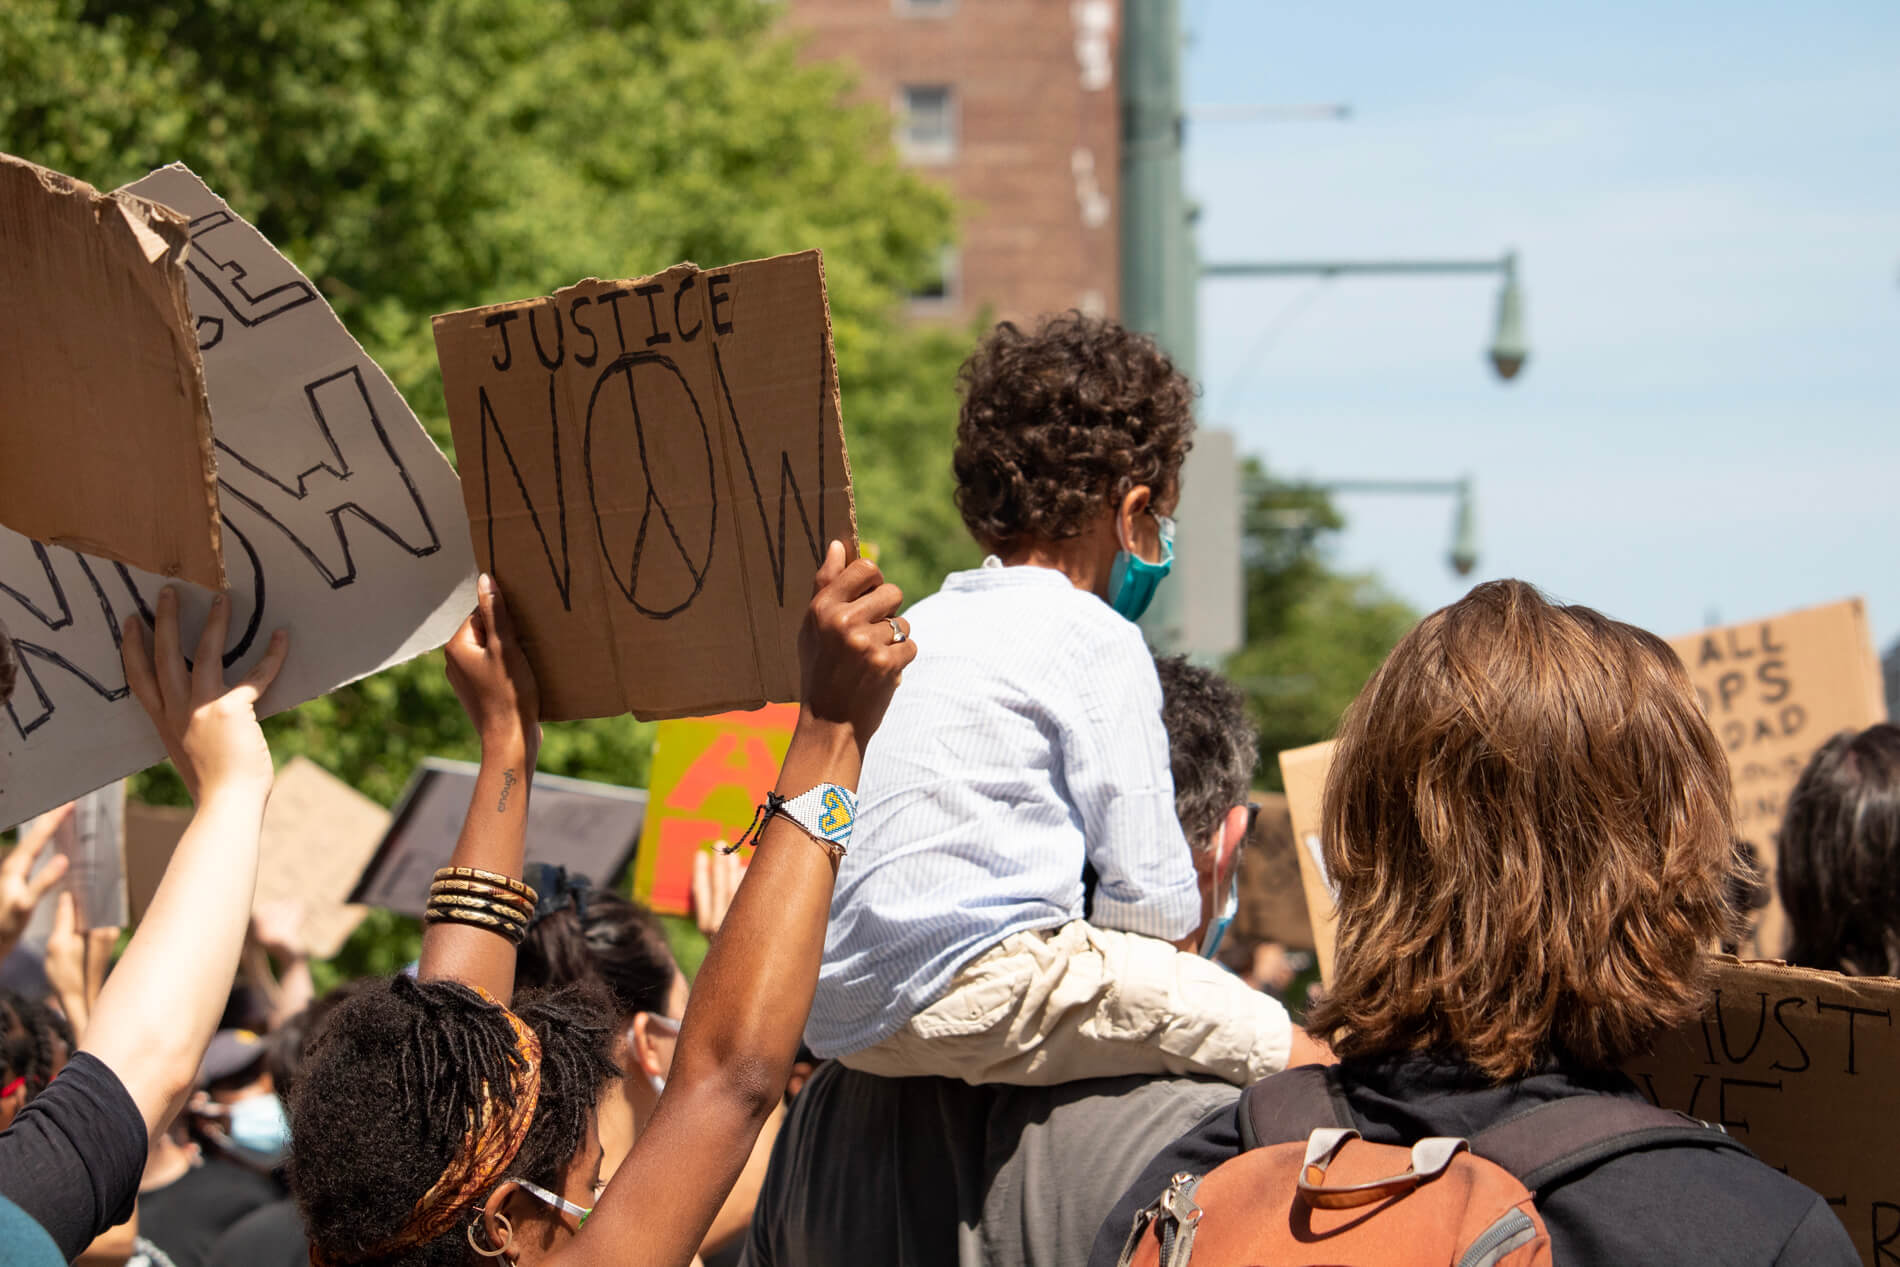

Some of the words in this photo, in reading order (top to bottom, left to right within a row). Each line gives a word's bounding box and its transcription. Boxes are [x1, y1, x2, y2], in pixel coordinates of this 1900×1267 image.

[486, 273, 734, 372] JUSTICE
[479, 333, 827, 620] NOW
[1697, 624, 1785, 667] ALL
